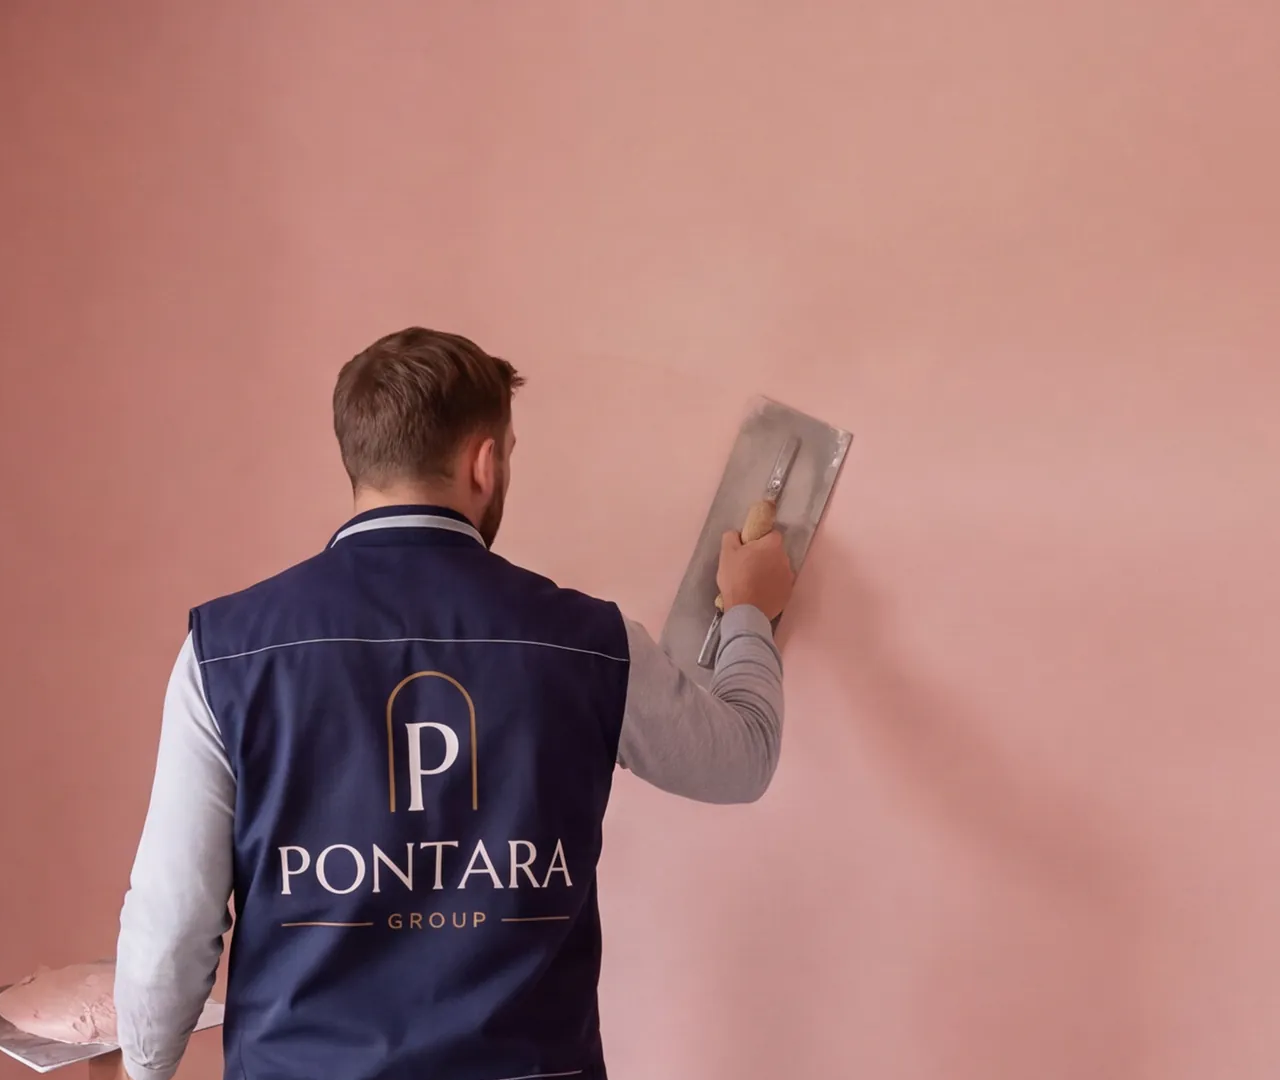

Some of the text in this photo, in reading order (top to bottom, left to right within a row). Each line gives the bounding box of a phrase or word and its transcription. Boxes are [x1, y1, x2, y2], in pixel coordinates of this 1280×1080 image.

[405, 722, 460, 811] P
[278, 838, 573, 895] PONTARA
[388, 911, 487, 930] GROUP
